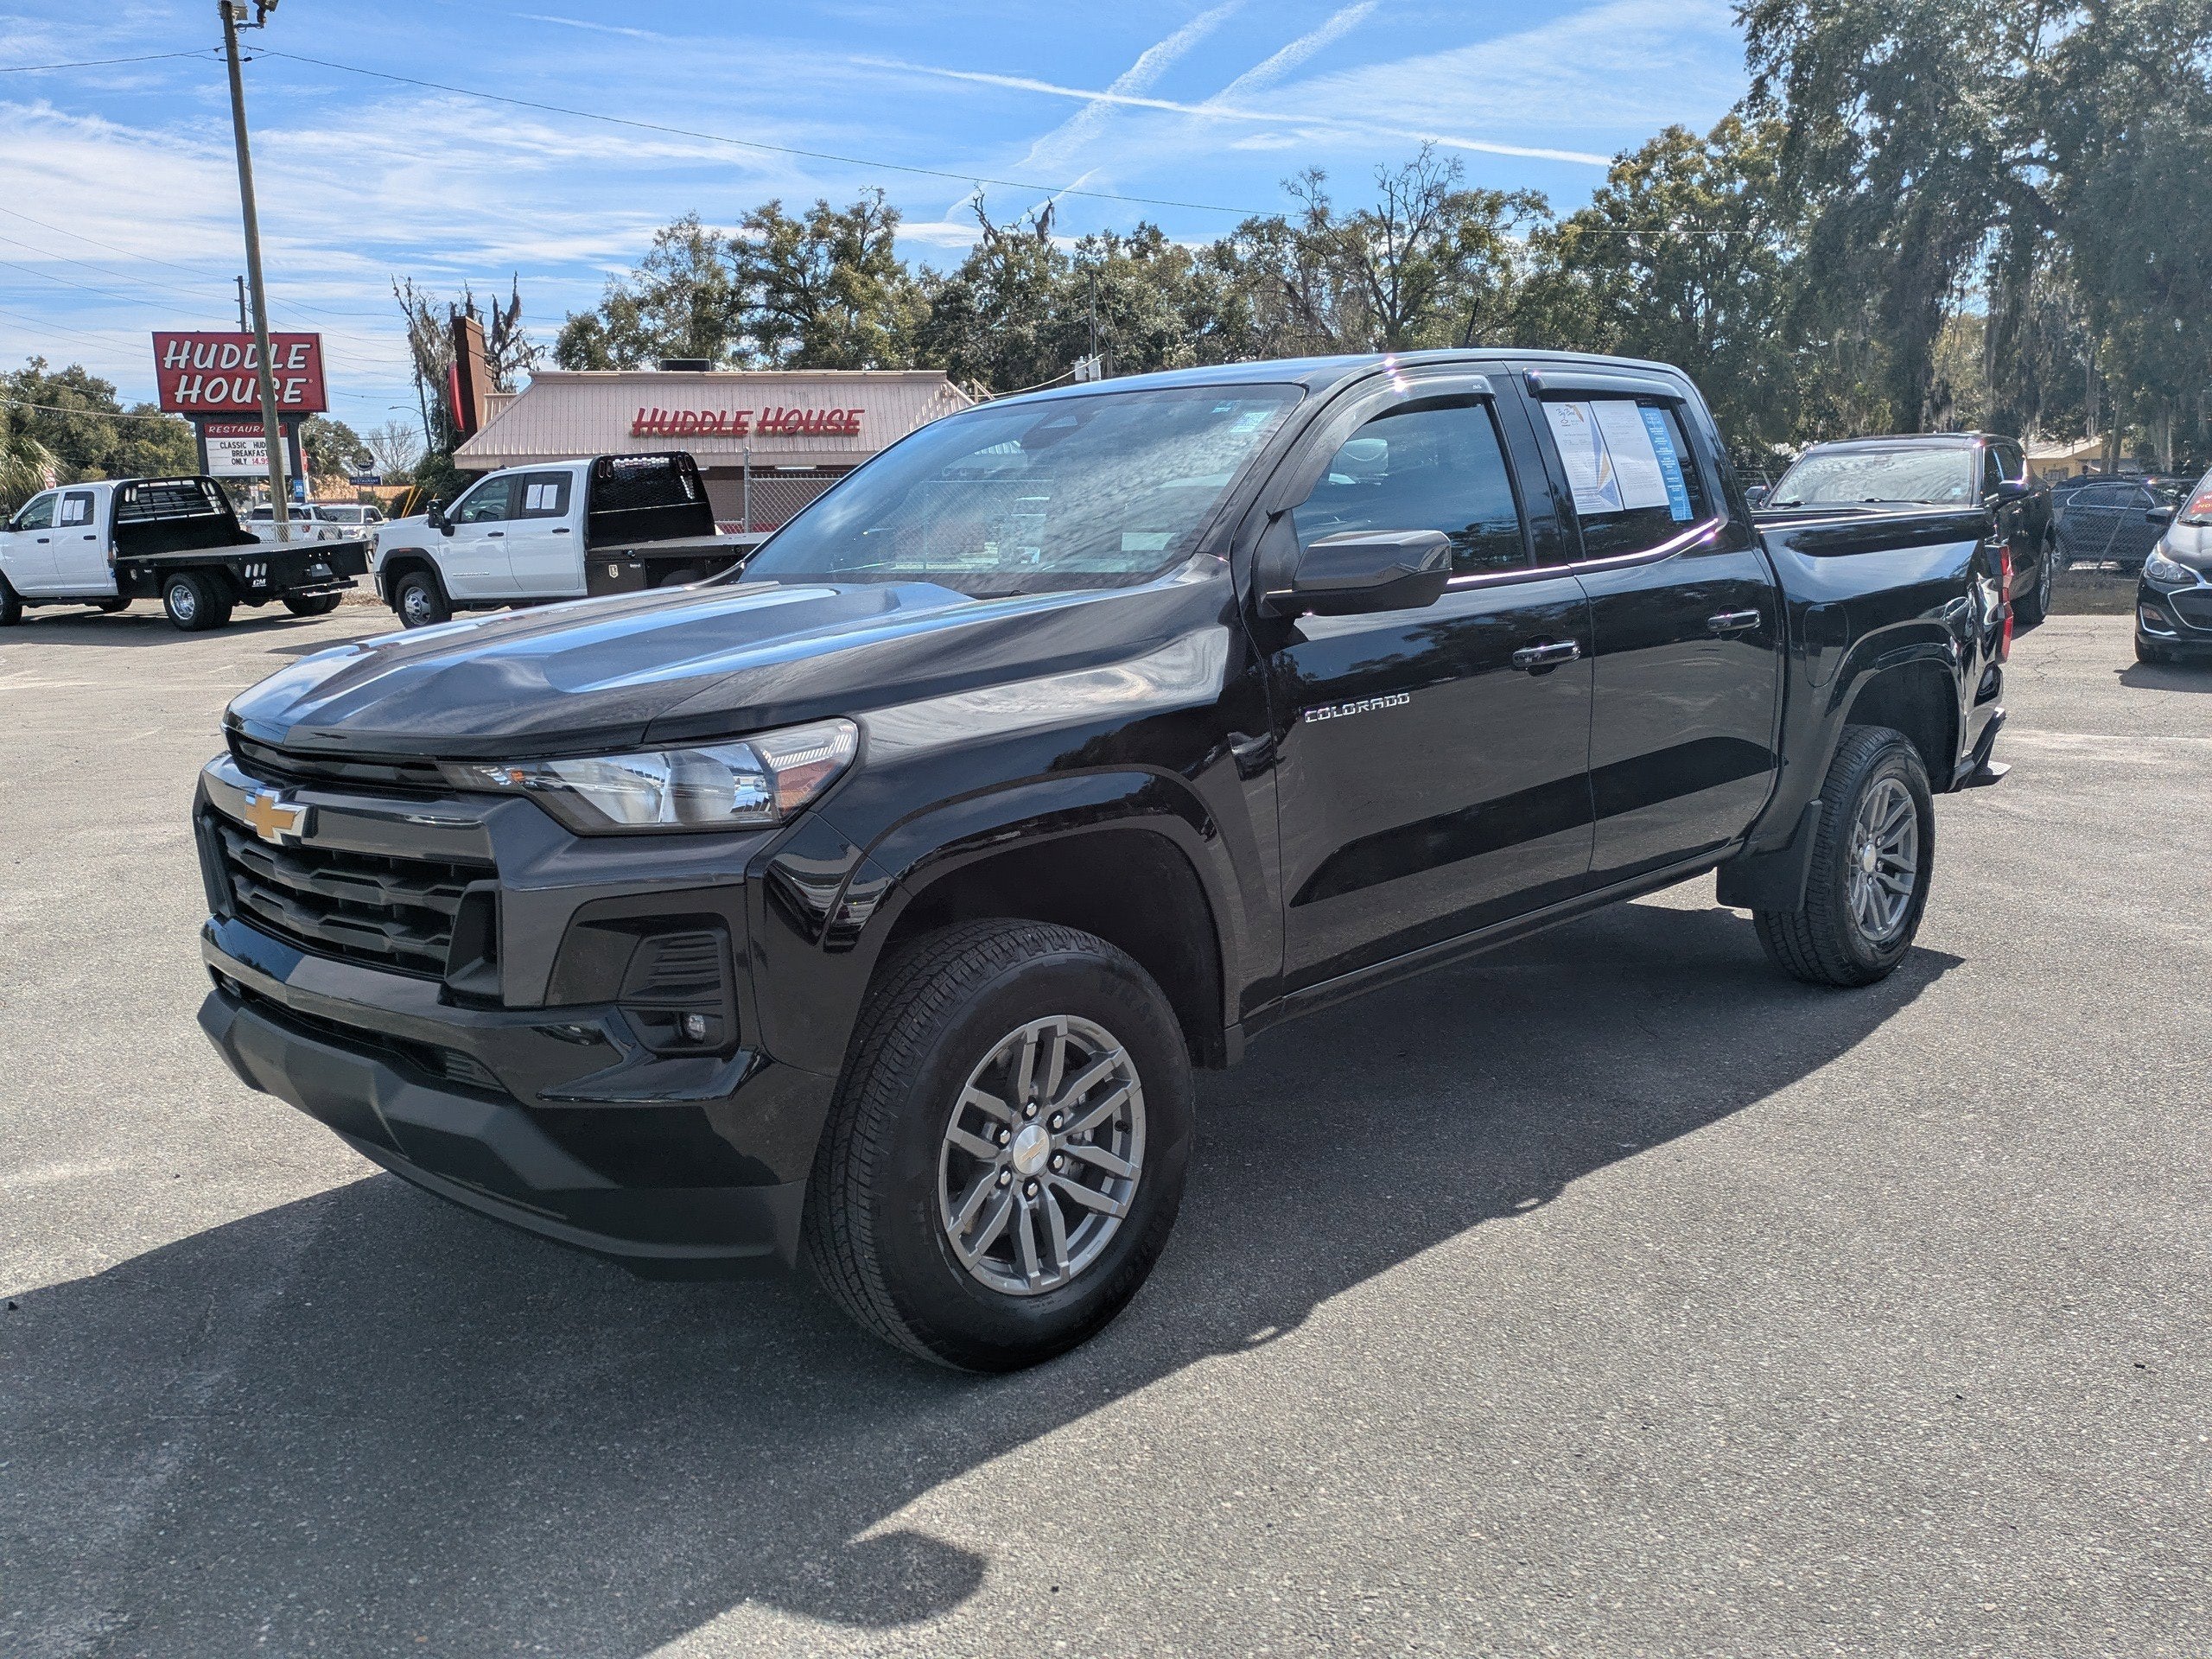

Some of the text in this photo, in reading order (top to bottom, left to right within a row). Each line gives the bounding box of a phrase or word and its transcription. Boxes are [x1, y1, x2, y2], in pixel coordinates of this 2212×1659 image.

[162, 340, 311, 369] HUDDLE
[632, 406, 866, 436] HUDDLE HOUSE
[1304, 692, 1410, 723] COLORADO
